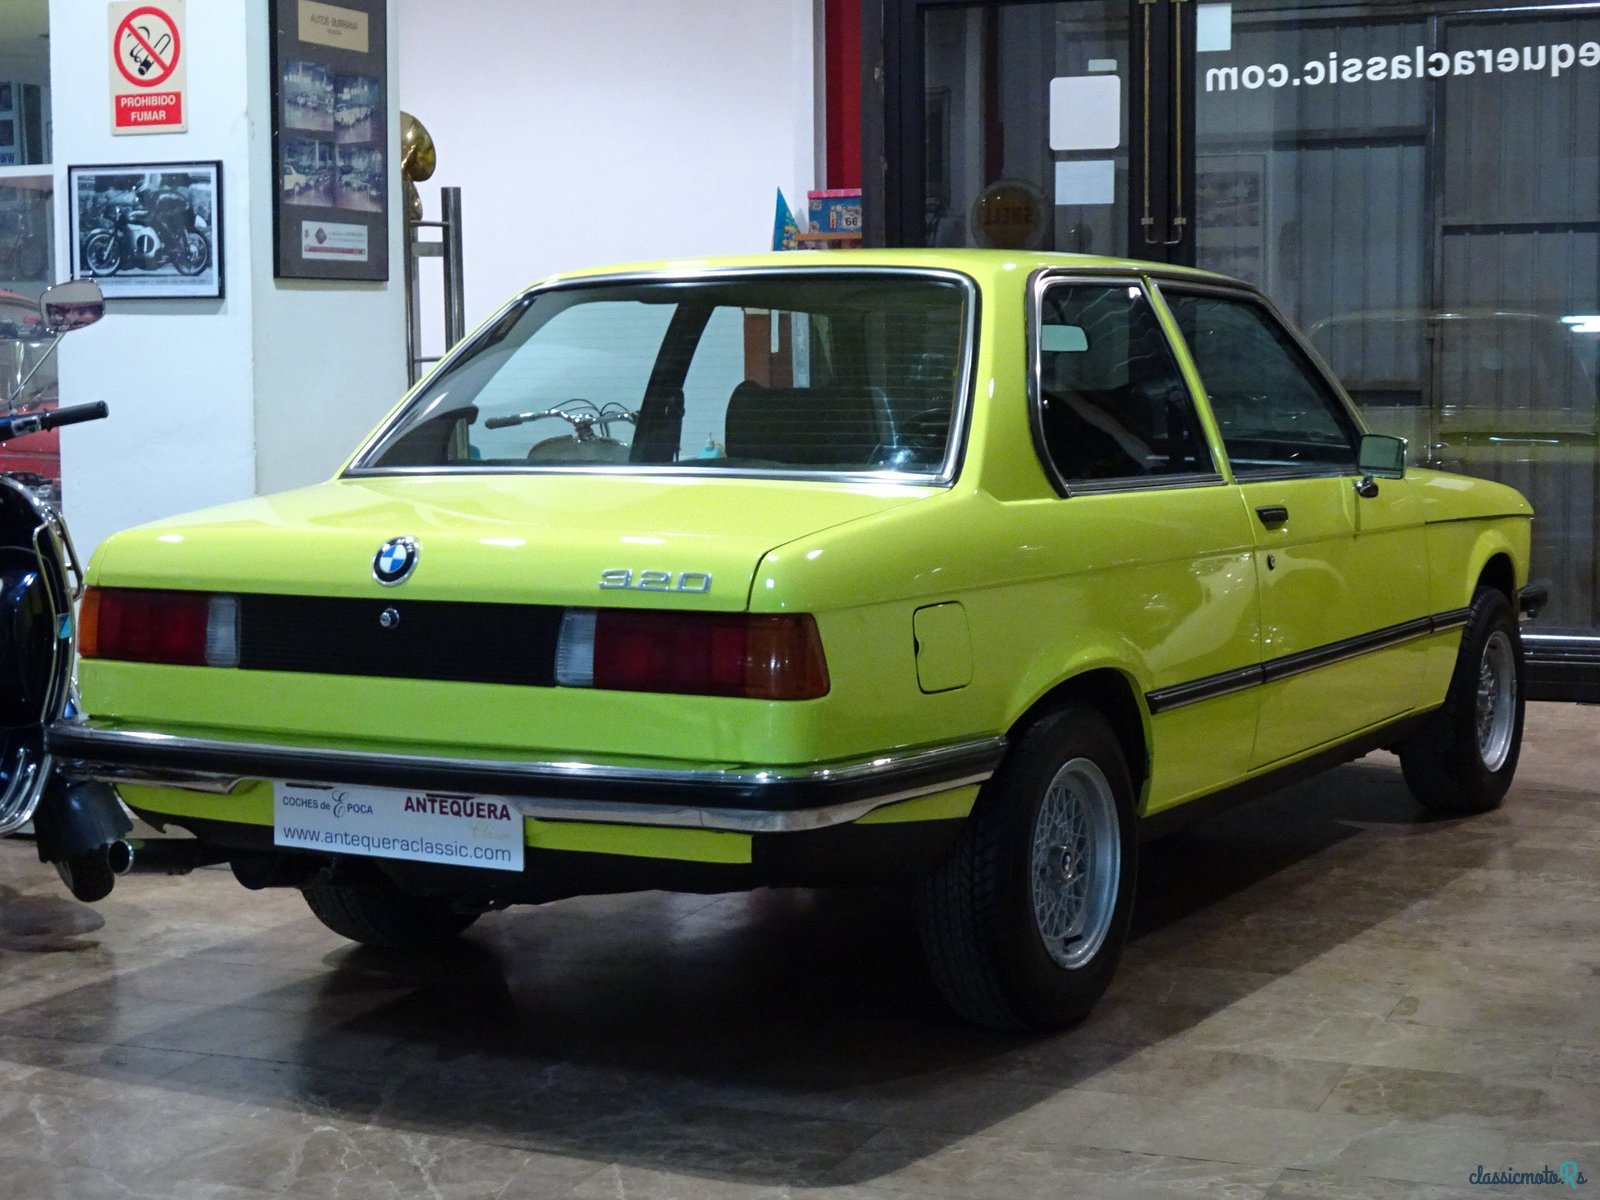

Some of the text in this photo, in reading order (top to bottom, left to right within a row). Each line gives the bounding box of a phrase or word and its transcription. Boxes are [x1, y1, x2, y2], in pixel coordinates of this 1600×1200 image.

[310, 14, 330, 26] AUTOS
[120, 95, 176, 108] PROHIBIDO
[131, 110, 166, 122] FUMAR
[844, 216, 859, 227] 66
[599, 568, 712, 594] 320
[282, 796, 319, 809] COCHES
[320, 801, 331, 811] de
[403, 796, 512, 821] ANTEQUERA
[283, 826, 512, 862] www.antequeraclassic.com
